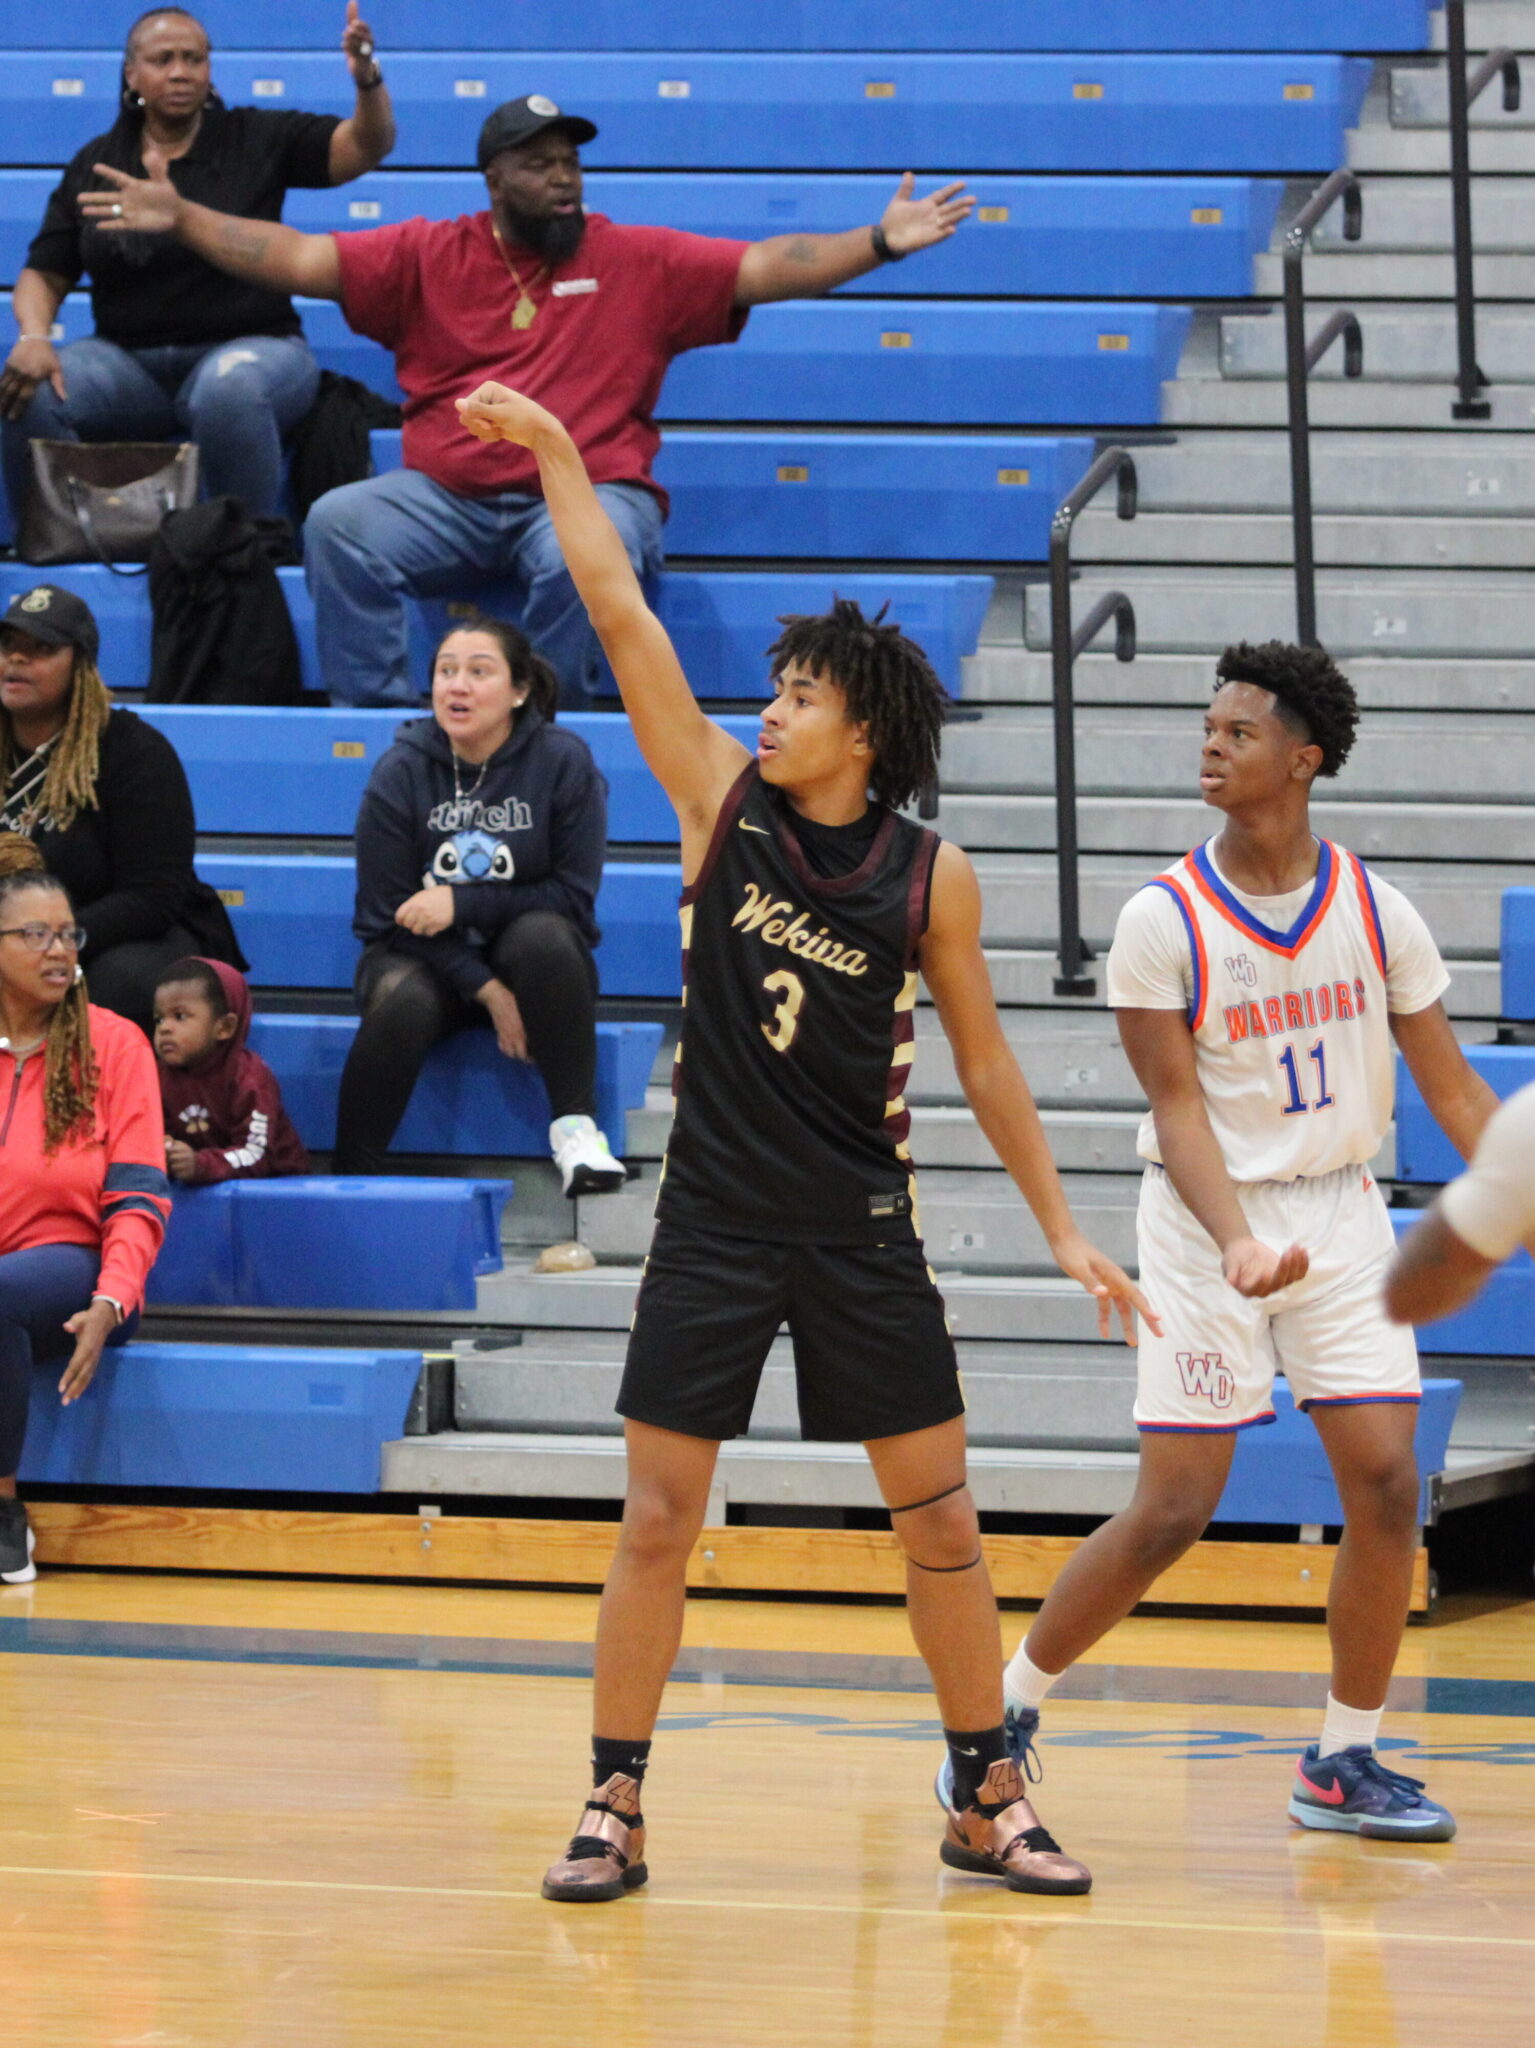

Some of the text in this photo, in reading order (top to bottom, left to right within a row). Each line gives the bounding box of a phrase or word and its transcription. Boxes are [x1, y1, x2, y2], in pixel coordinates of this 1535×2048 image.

[731, 882, 868, 976] Wekiva
[1224, 953, 1257, 988] WO
[761, 969, 804, 1052] 3
[1223, 976, 1366, 1044] WARRIORS
[1078, 1070, 1088, 1082] C
[1277, 1037, 1335, 1117] 11
[1175, 1352, 1235, 1409] WO
